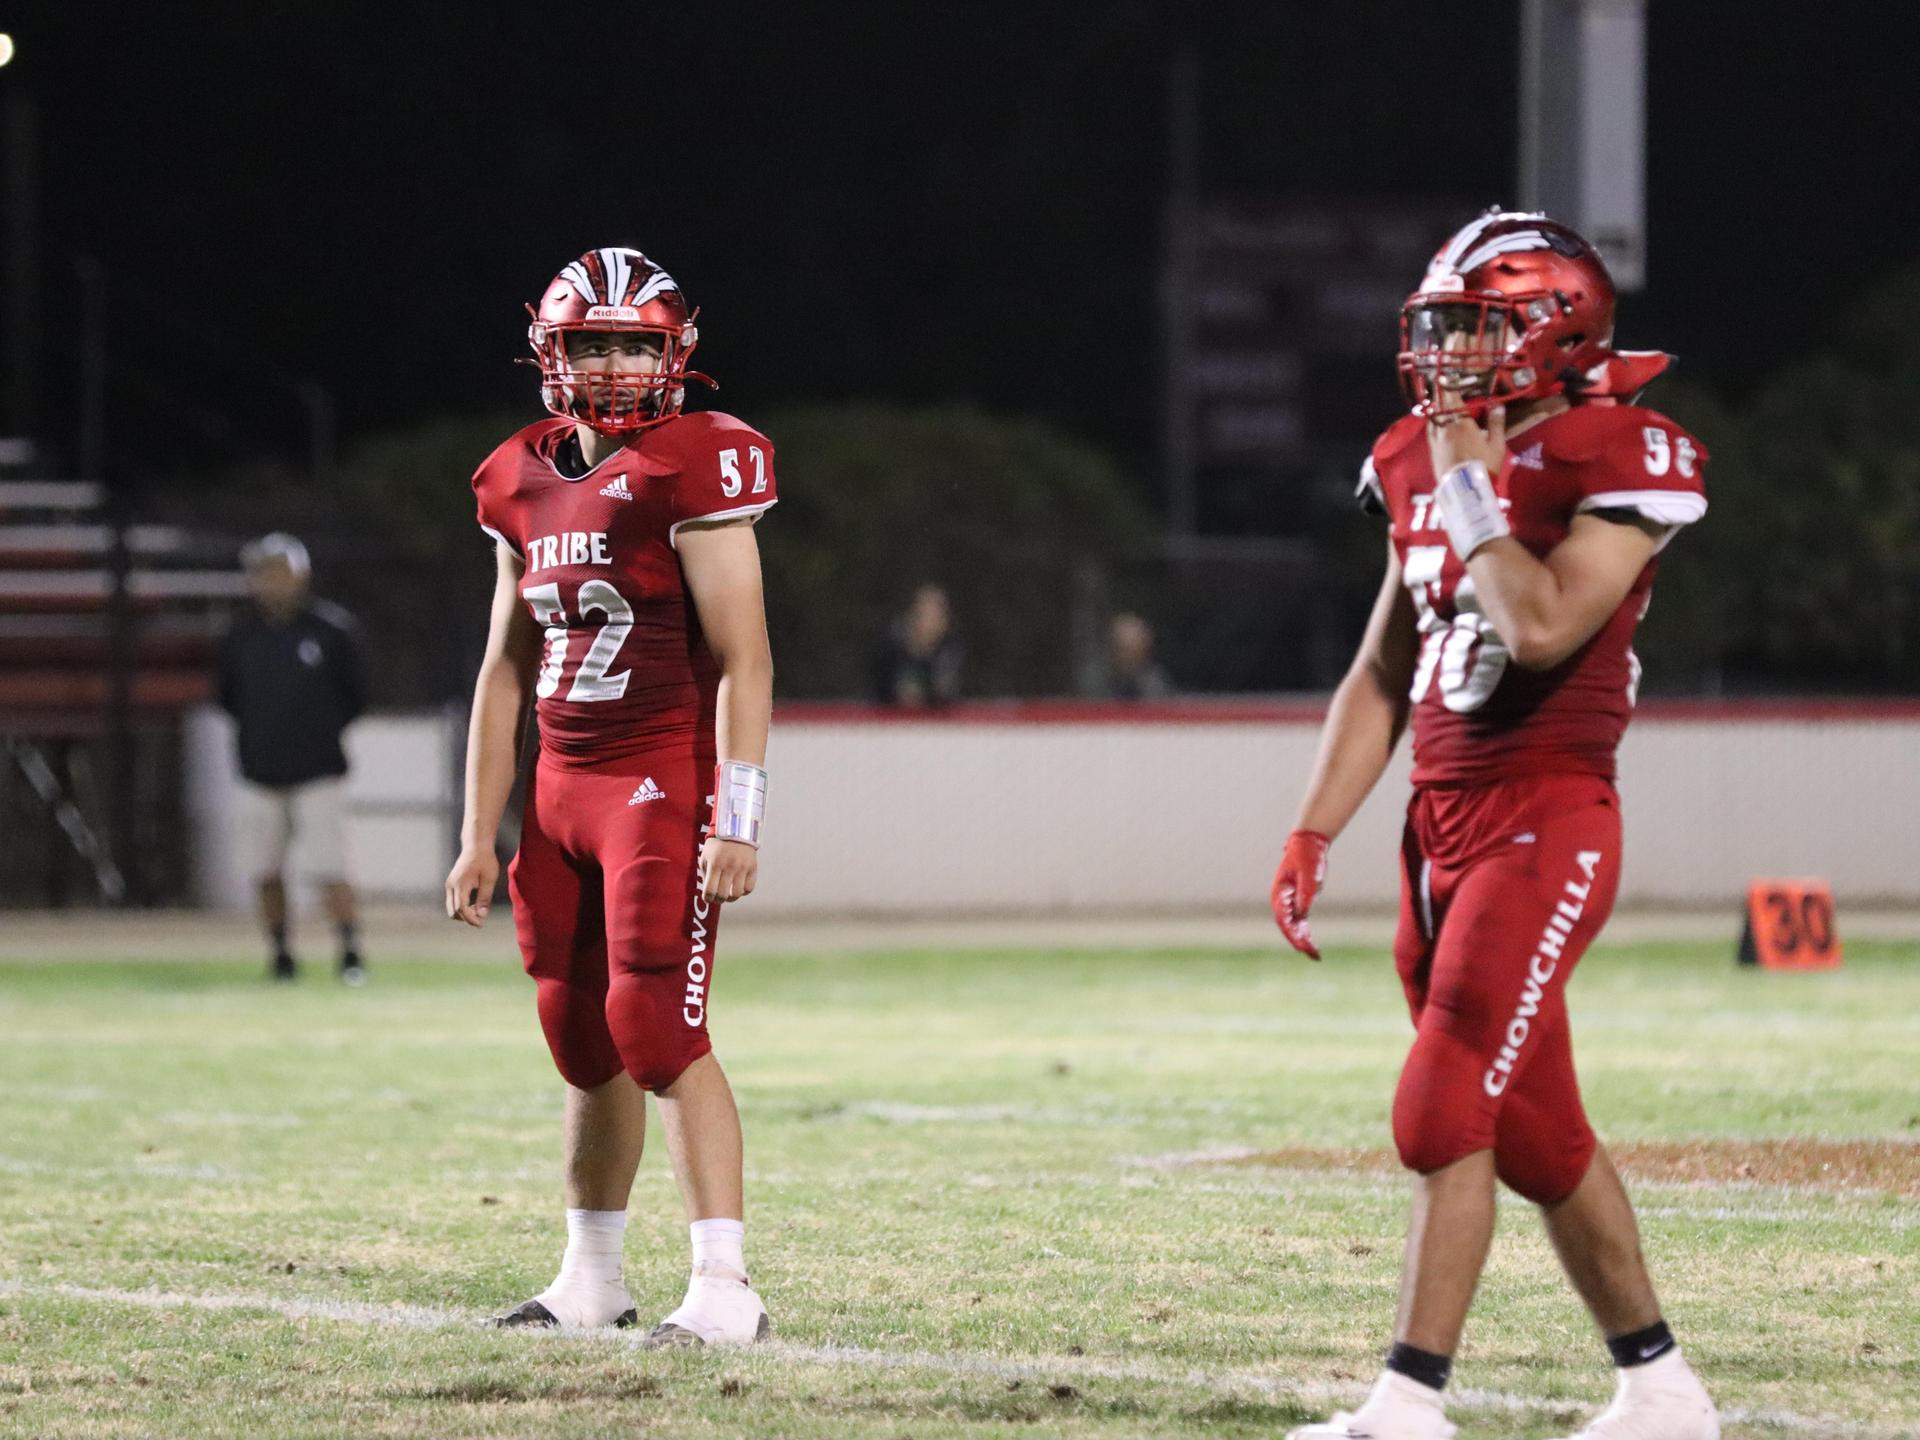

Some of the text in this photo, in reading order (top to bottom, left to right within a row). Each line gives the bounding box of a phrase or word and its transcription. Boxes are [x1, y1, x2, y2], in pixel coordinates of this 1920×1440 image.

[599, 487, 633, 501] adidas
[718, 446, 768, 498] 52
[527, 532, 613, 573] TRIBE
[522, 579, 635, 702] 52
[628, 791, 666, 806] adidas
[1767, 893, 1832, 955] 30
[1483, 850, 1602, 1097] CHOWCHILLA
